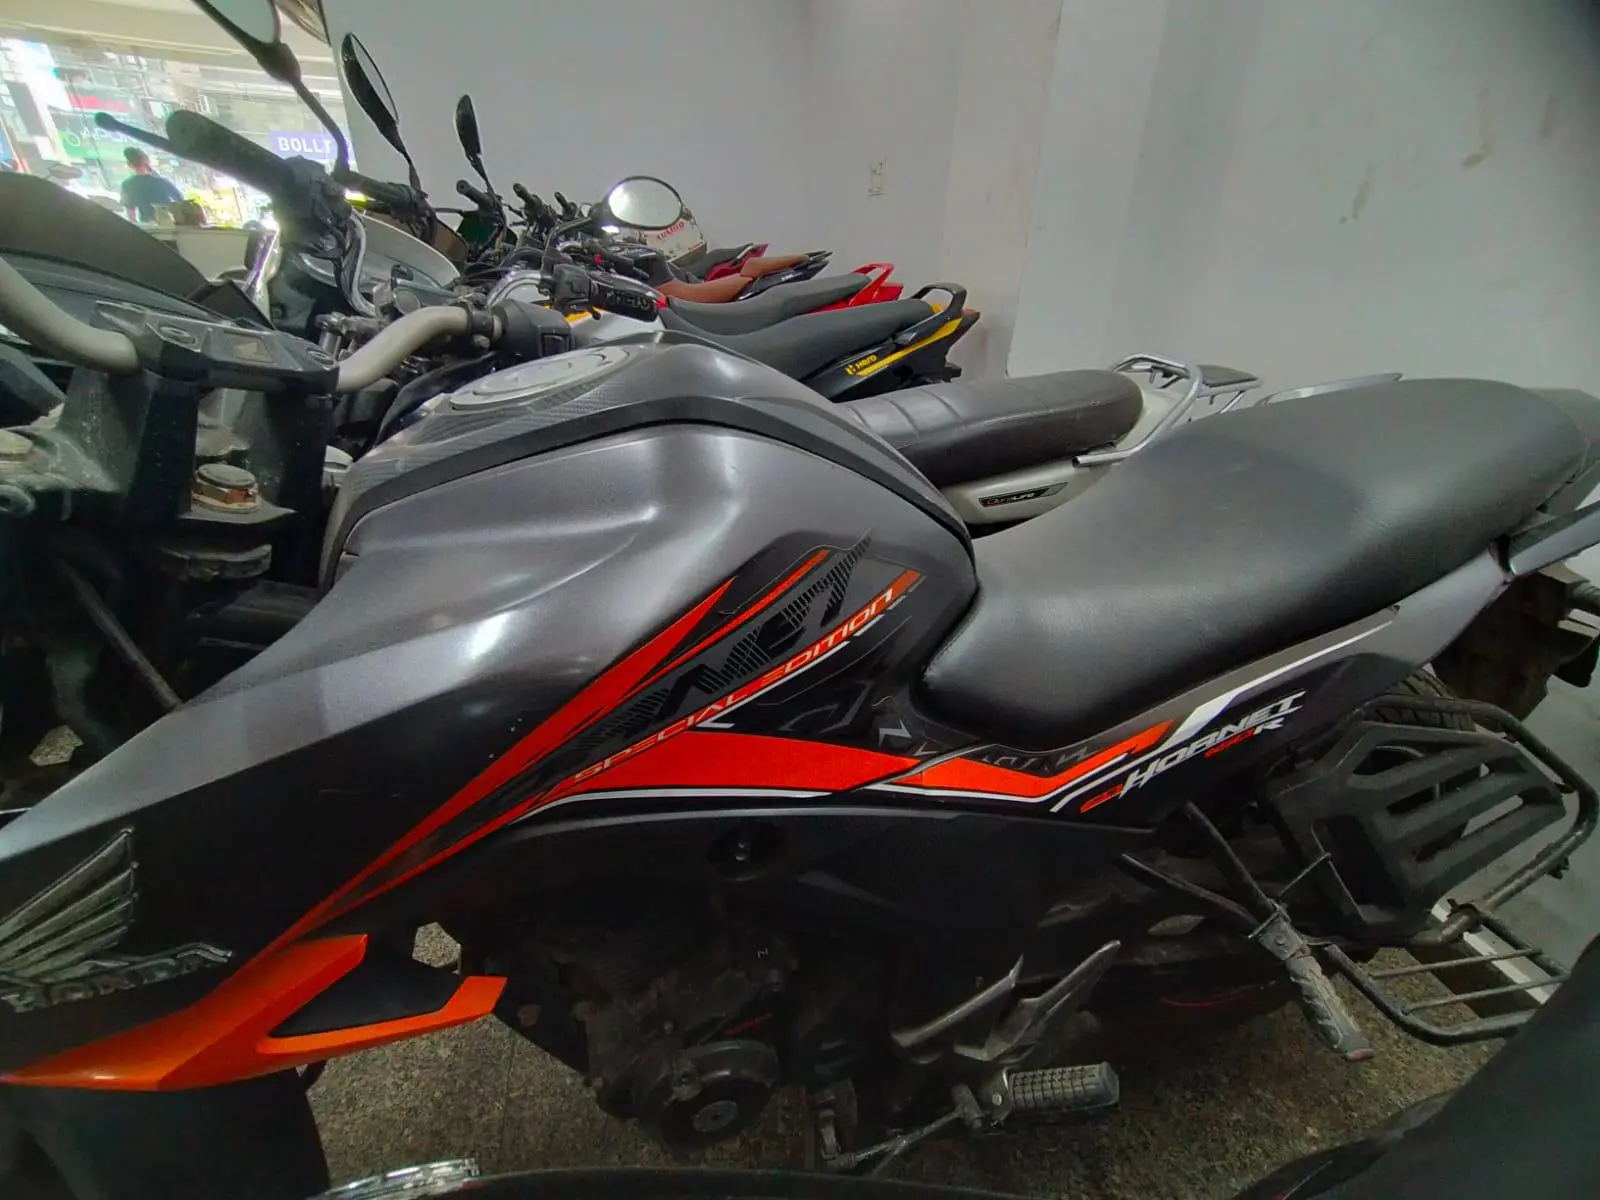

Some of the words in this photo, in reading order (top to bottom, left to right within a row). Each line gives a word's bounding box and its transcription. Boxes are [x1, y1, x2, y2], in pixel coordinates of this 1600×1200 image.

[574, 693, 748, 783] SPECIAL
[761, 587, 893, 683] EDITION
[1119, 689, 1307, 799] HORNET
